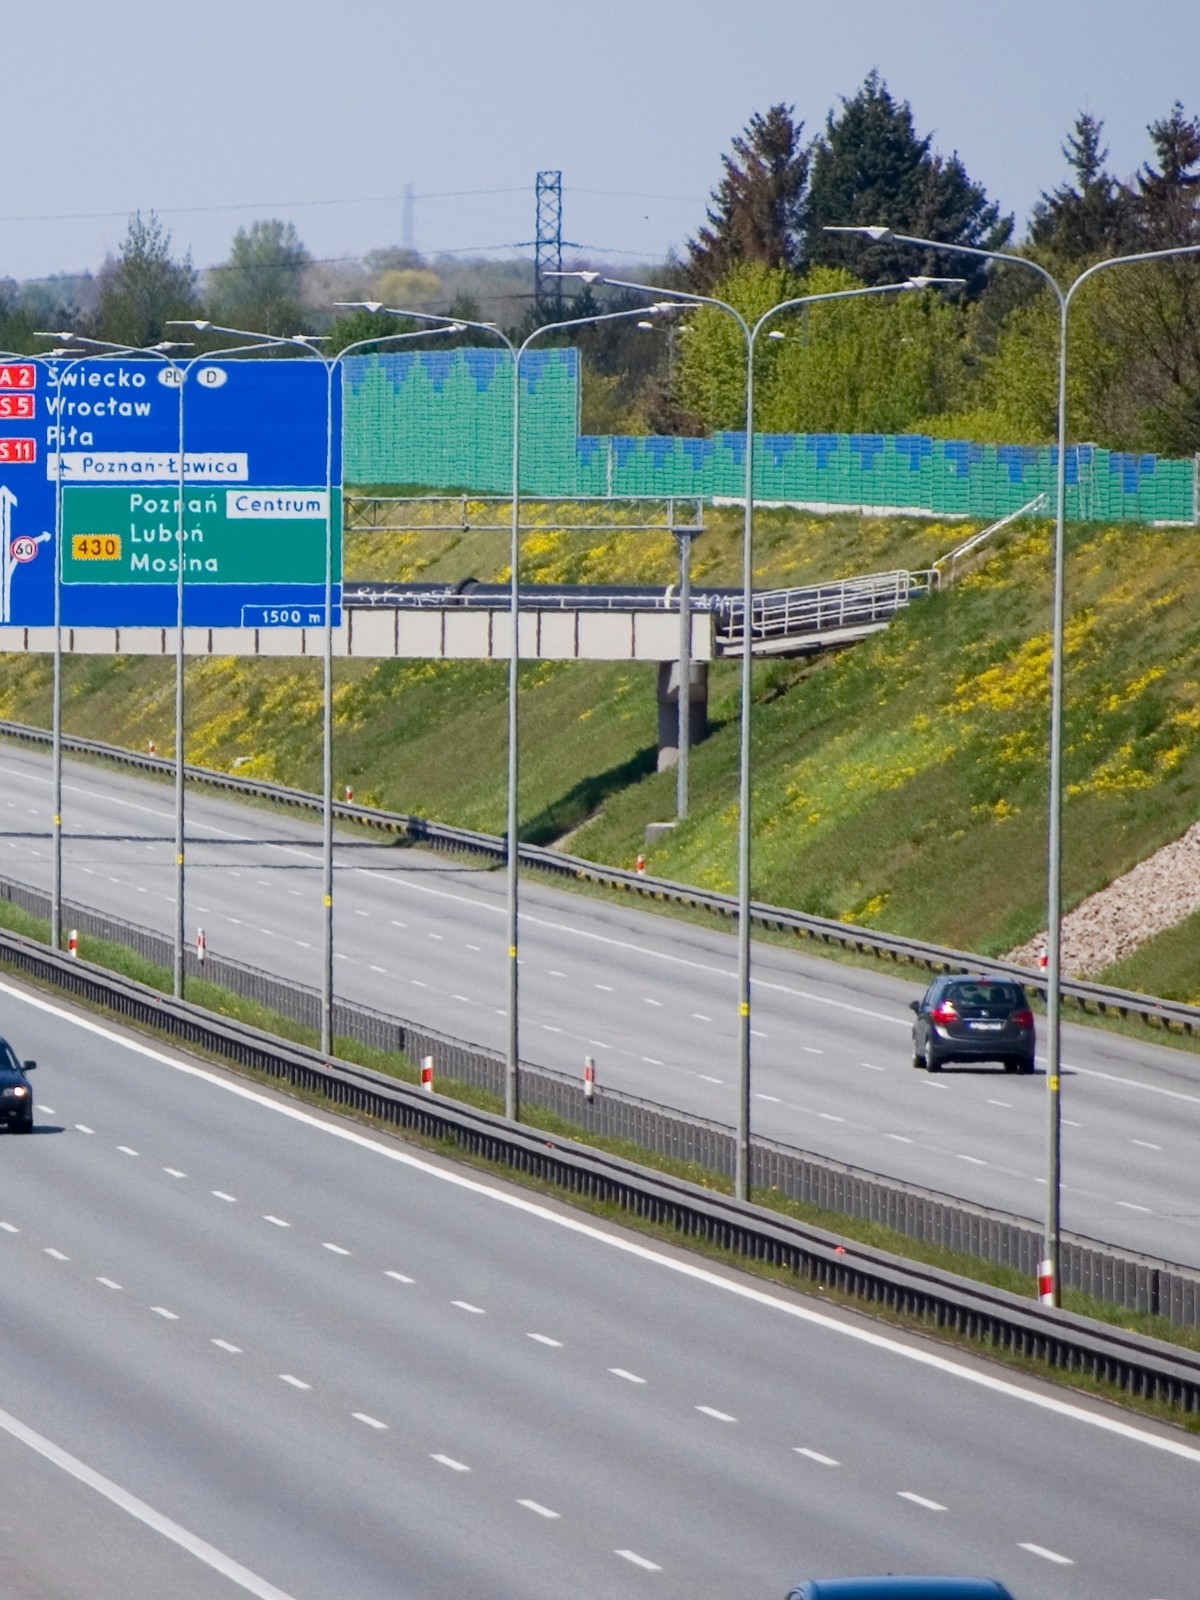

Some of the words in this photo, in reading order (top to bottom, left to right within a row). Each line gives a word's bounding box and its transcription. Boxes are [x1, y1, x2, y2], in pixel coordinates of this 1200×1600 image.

[46, 361, 146, 387] Świecko
[165, 371, 181, 384] PL
[207, 371, 217, 384] D
[45, 396, 151, 416] Wrocław
[46, 426, 94, 446] Piła
[83, 458, 238, 474] Poznań-Ławica
[130, 493, 217, 513] Poznań
[236, 496, 320, 511] Centrum
[130, 523, 203, 542] Luboń
[15, 543, 33, 555] 60
[78, 540, 115, 555] 430
[130, 552, 218, 572] Mosina
[263, 610, 300, 623] 1500
[308, 613, 320, 623] m
